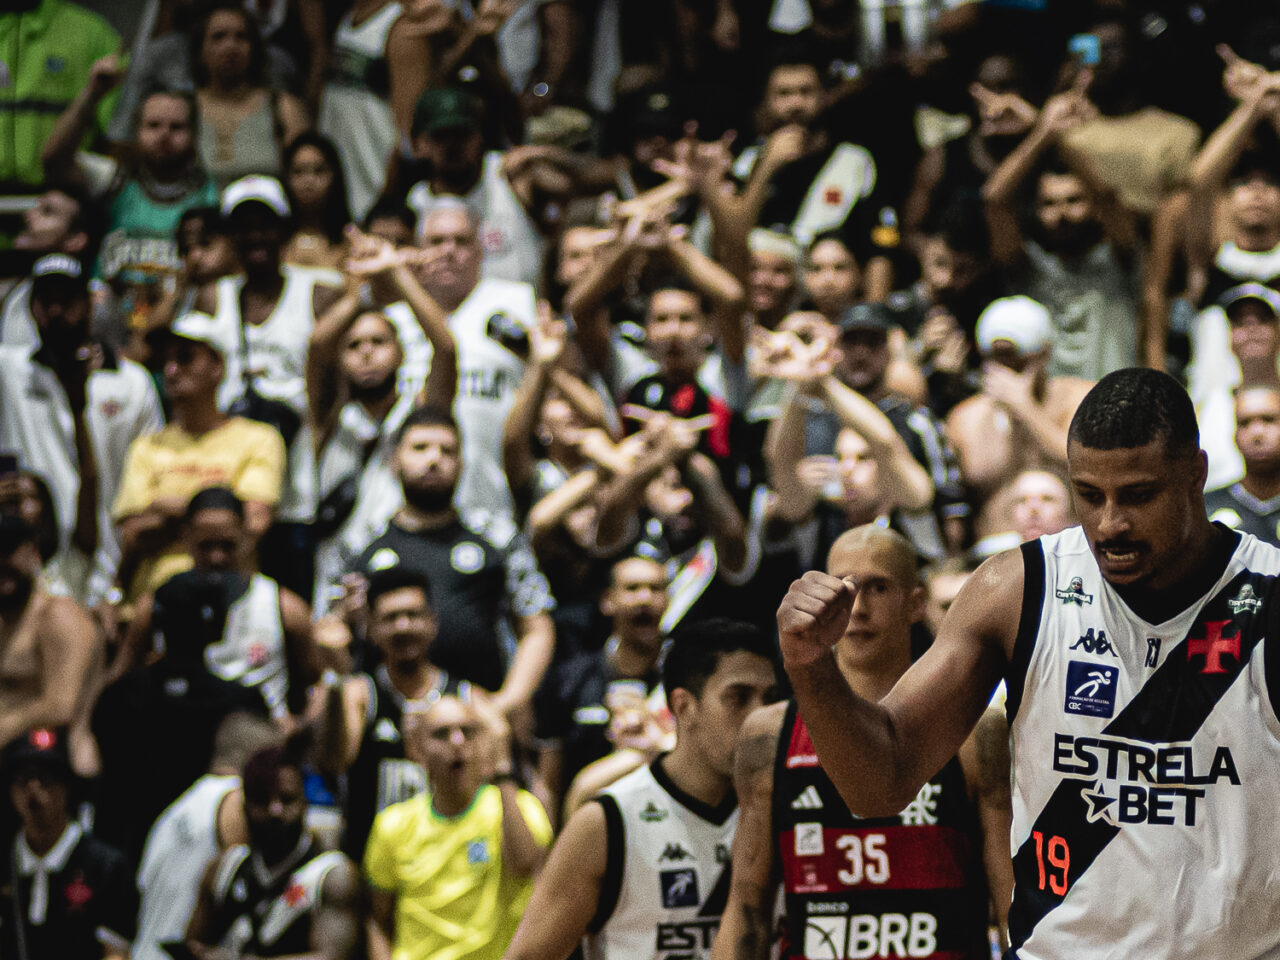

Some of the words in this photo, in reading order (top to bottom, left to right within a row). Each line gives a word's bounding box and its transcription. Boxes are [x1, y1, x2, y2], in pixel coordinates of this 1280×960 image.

[1053, 732, 1242, 785] ESTRELA
[1118, 784, 1206, 826] BET
[836, 833, 891, 885] 35
[1032, 830, 1070, 896] 19
[848, 912, 938, 960] BRB
